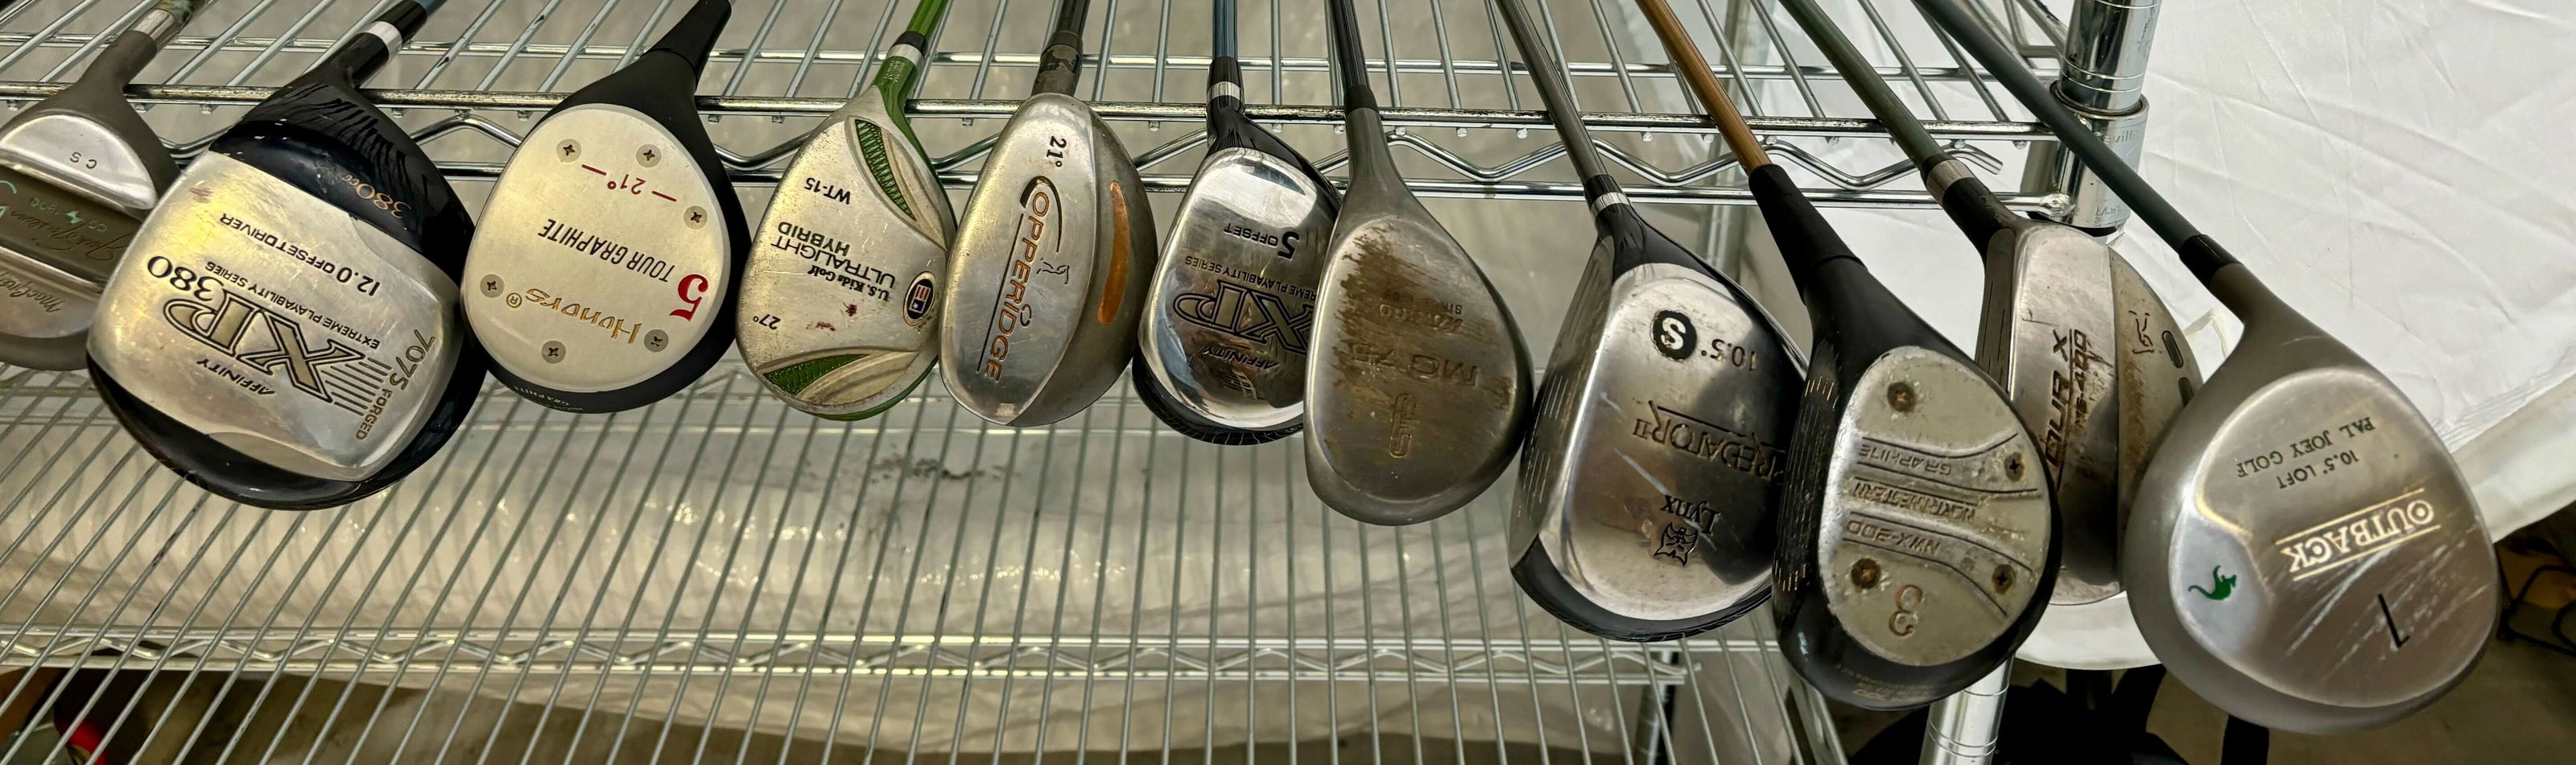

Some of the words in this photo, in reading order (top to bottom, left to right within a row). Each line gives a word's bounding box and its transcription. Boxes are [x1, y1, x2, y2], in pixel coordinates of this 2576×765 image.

[1046, 135, 1067, 168] 21°
[341, 172, 412, 219] 380cc
[804, 177, 852, 205] WT-15
[219, 212, 278, 247] DRIVER
[537, 218, 629, 266] GRAPHITE
[778, 221, 851, 257] HYBRID
[1224, 221, 1279, 248] OFFSET
[1277, 230, 1300, 260] 5
[205, 261, 249, 287] SERIES
[275, 240, 336, 275] OFFSET
[626, 250, 675, 283] TOUR
[770, 236, 896, 289] ULTRALIGHT
[807, 264, 836, 283] Golf
[1184, 254, 1223, 275] SERIES
[147, 254, 225, 302] 380
[336, 267, 382, 297] 12.0
[837, 274, 865, 293] Kids
[868, 284, 890, 303] U.S.
[985, 175, 1063, 383] COPPERIDGE
[1222, 264, 1289, 293] PLAYABILITY
[1288, 287, 1317, 303] REME
[248, 283, 323, 325] PLAYABILITY
[669, 273, 709, 322] 5
[524, 287, 642, 345] Honors
[753, 313, 781, 331] 27°
[1173, 279, 1315, 357] XP
[1660, 316, 1687, 350] S
[163, 289, 365, 404] XP
[323, 317, 381, 350] EXTREME
[389, 329, 437, 391] 7075
[1203, 345, 1281, 370] AFFINITY
[196, 358, 277, 396] AFFINITY
[355, 387, 394, 441] FORGED
[2339, 416, 2376, 439] PAL
[1860, 444, 1952, 477] GRAPHITE
[2289, 429, 2334, 459] JOEY
[2236, 450, 2283, 478] GOLF
[2277, 465, 2317, 490] LOFT
[1660, 494, 1721, 536] Lynx
[1847, 519, 1941, 556] NWX-200
[2280, 498, 2434, 573] OUTBACK
[1889, 583, 1926, 638] 3
[2377, 593, 2410, 649] 1
